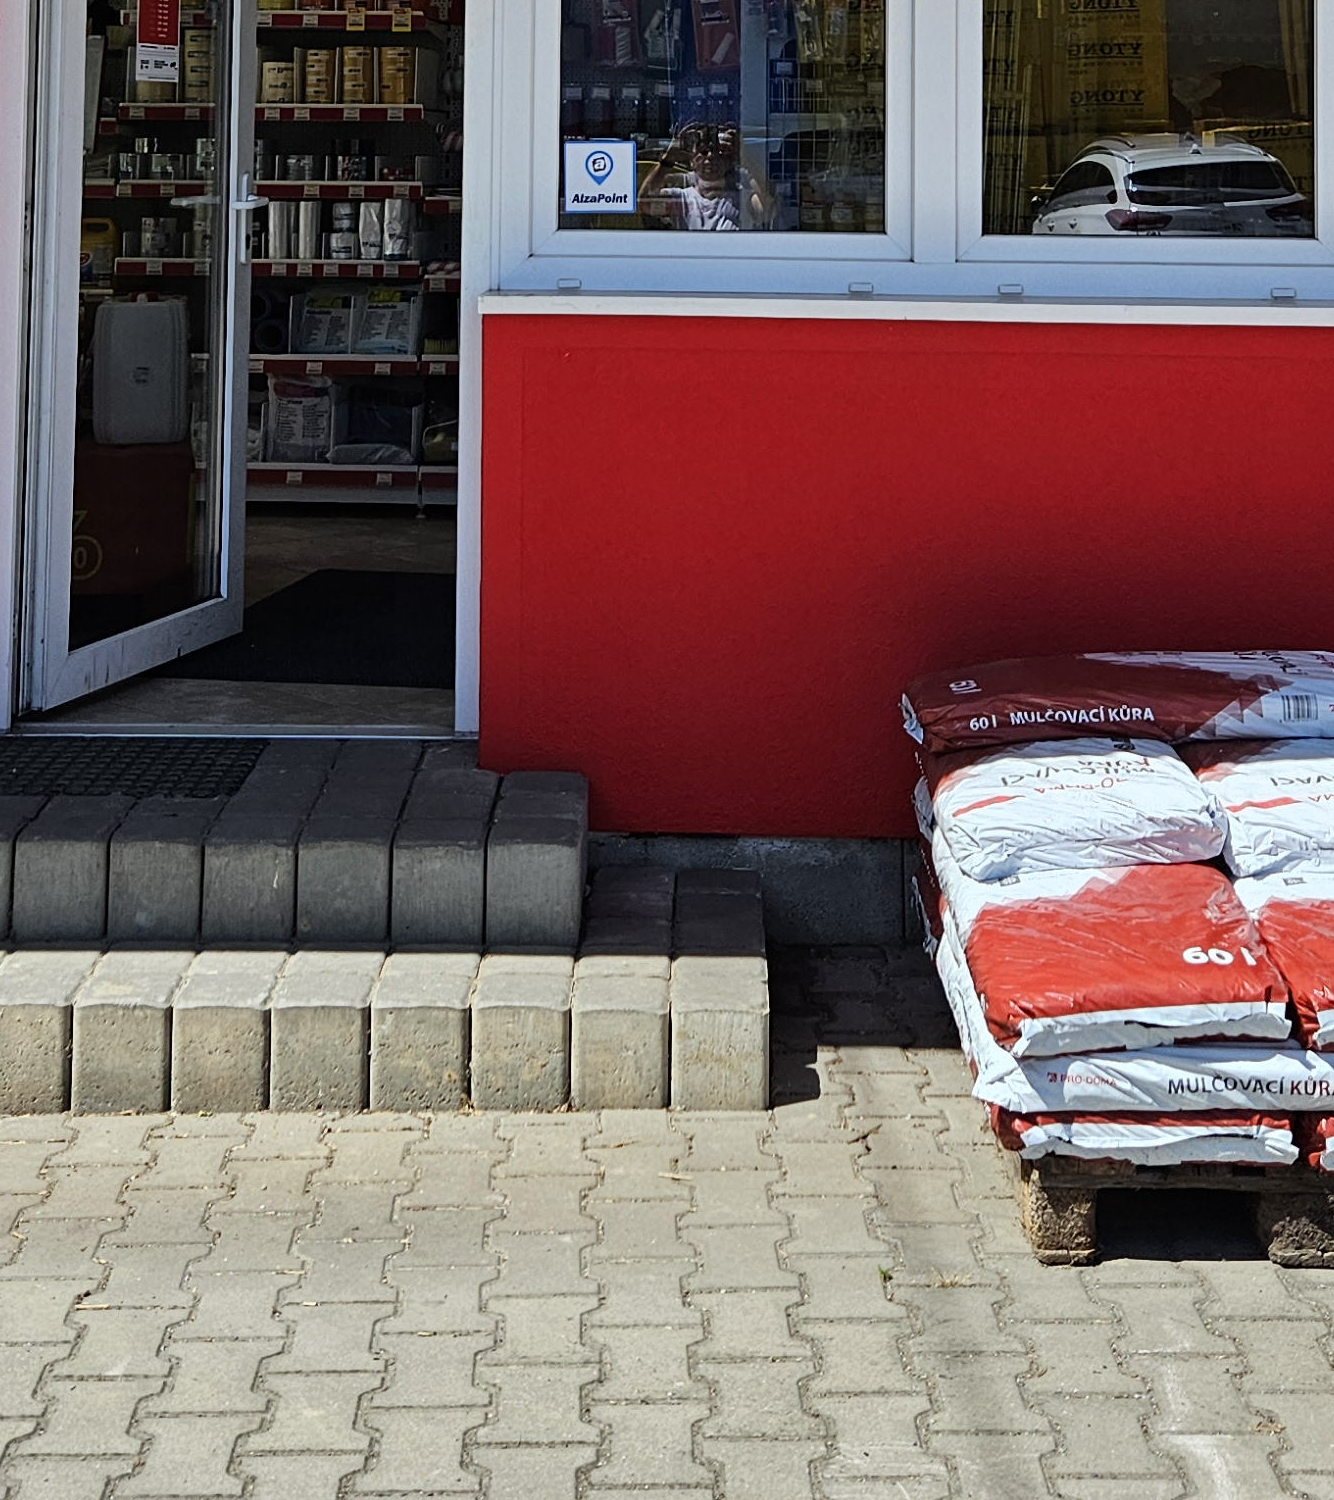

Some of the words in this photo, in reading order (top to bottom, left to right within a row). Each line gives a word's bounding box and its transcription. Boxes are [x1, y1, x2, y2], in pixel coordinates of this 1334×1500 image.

[572, 193, 628, 204] AlzaPoint
[969, 717, 989, 731] 60
[1010, 705, 1105, 725] MULČOVACÍ
[1107, 705, 1155, 721] KŮRA
[1182, 946, 1234, 965] 60
[1060, 1073, 1117, 1087] PRO-DOMA
[1168, 1074, 1285, 1095] MULČOVACÍ
